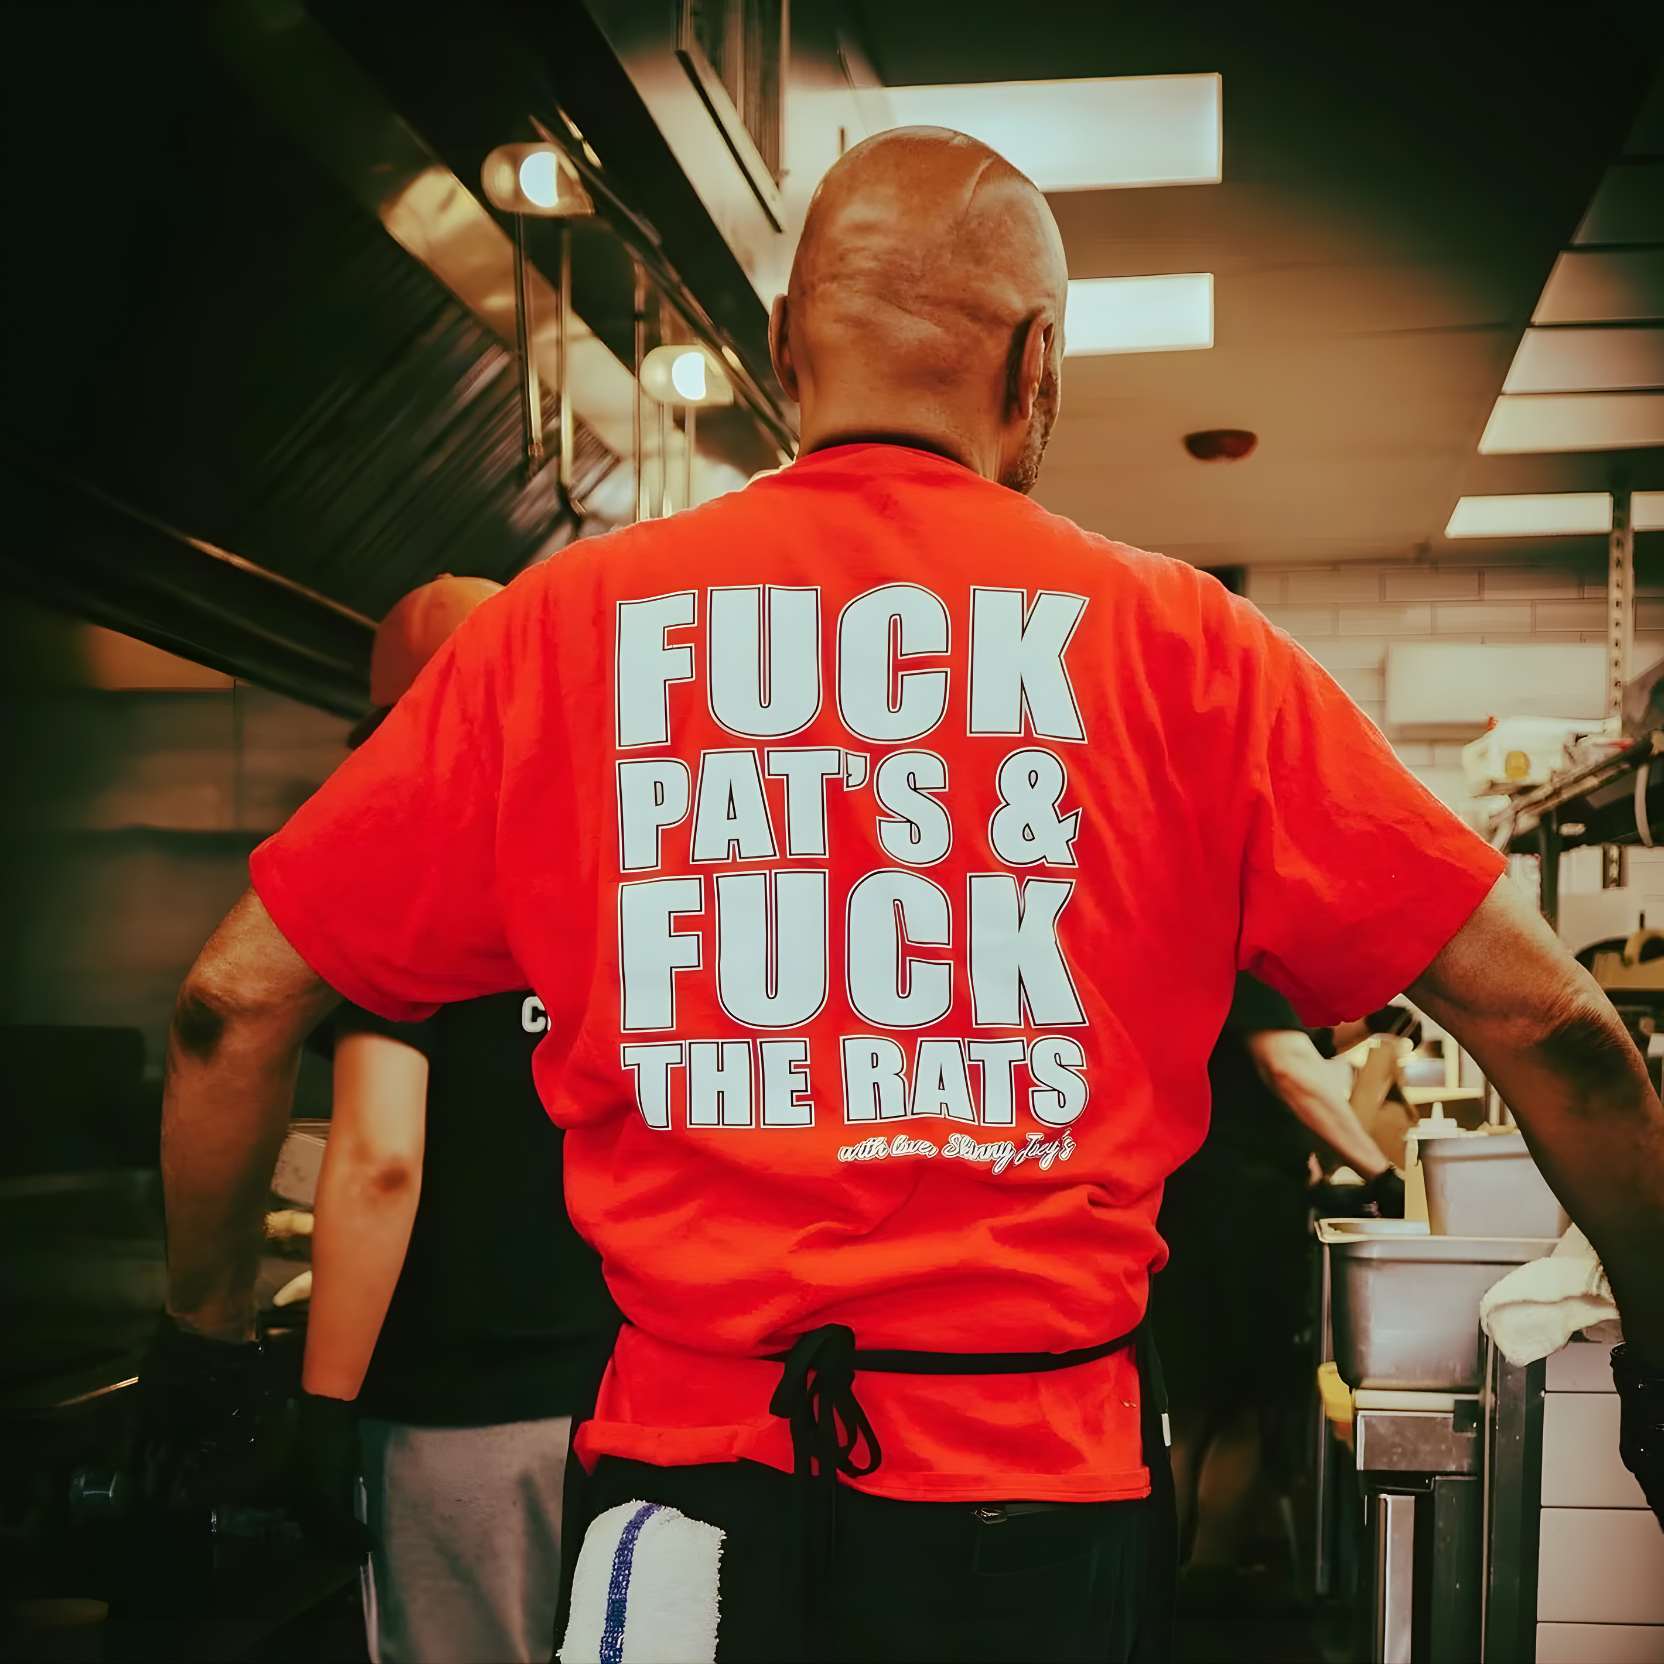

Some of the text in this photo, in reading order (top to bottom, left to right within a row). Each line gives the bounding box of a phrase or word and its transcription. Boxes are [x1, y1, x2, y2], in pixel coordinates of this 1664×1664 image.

[616, 582, 1089, 749] FUCK
[616, 747, 1082, 871] PAT'S &
[618, 869, 1089, 1033] FUCK
[620, 1035, 1089, 1130] THE RATS
[837, 1136, 890, 1162] with
